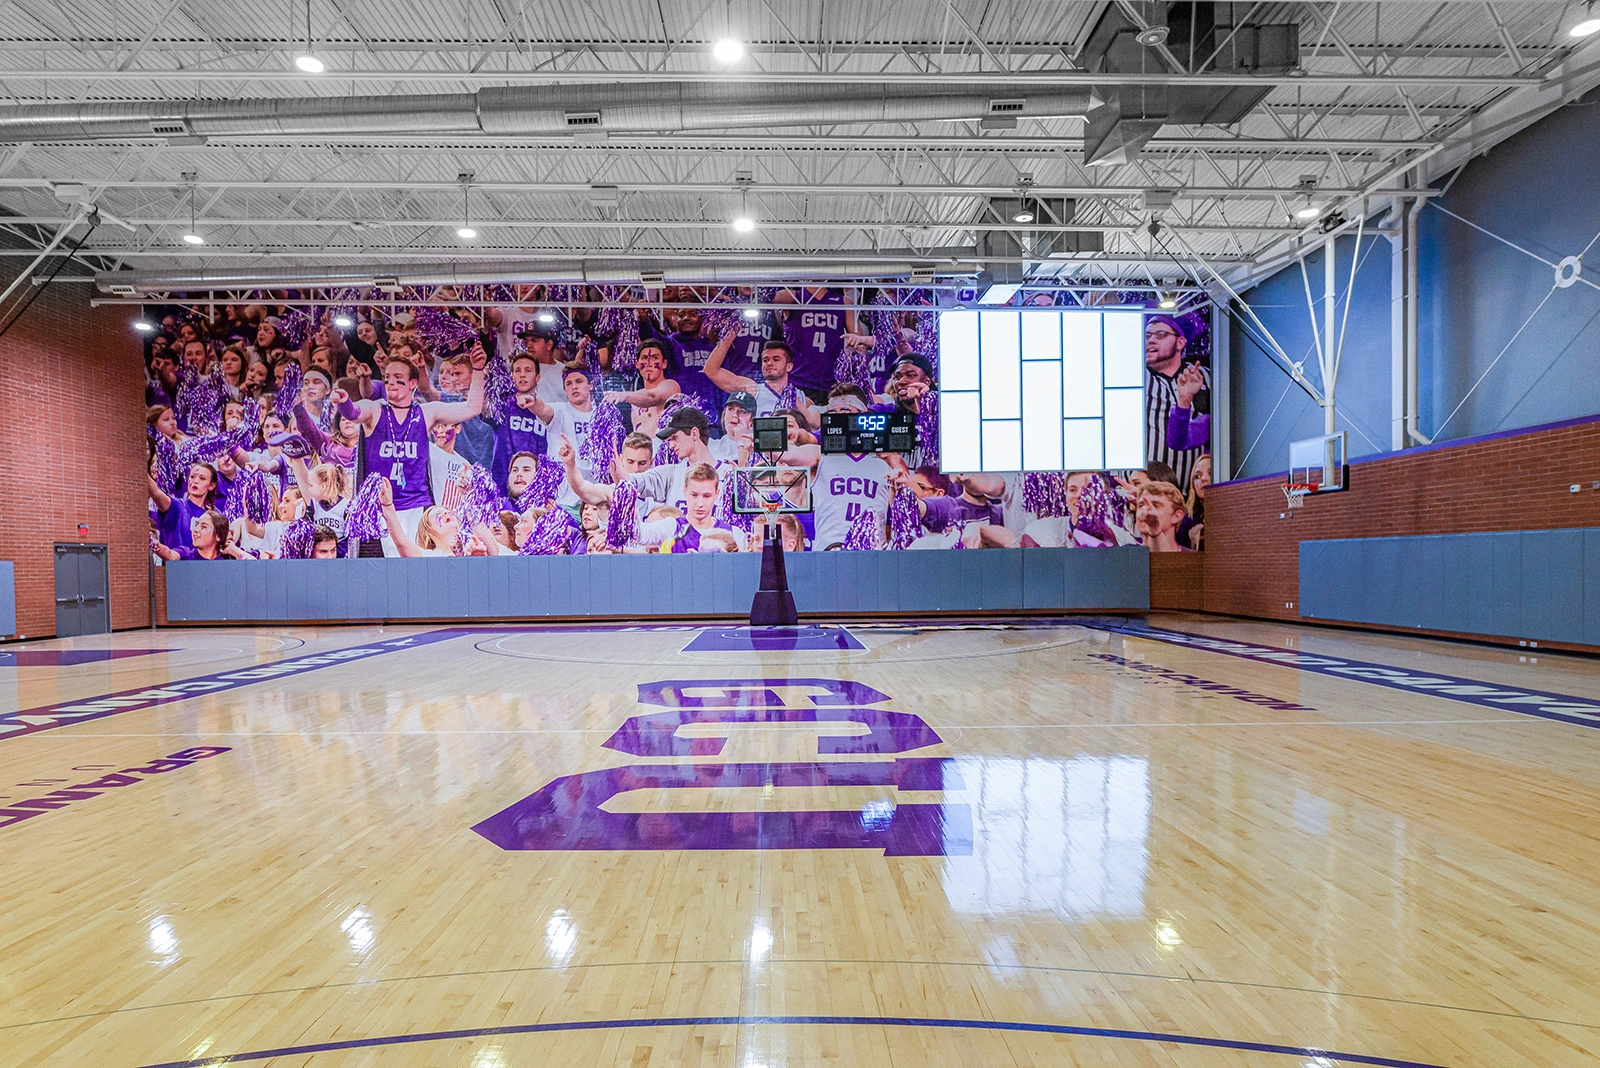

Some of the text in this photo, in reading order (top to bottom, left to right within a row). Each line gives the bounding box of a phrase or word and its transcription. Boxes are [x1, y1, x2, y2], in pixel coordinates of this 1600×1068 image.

[801, 312, 839, 330] GCU
[746, 341, 760, 363] 4
[812, 332, 826, 353] 4
[509, 415, 546, 437] GCU
[827, 427, 843, 435] LOPES
[858, 415, 886, 430] 9:52
[891, 426, 909, 434] GUEST
[379, 440, 419, 459] GCU
[829, 477, 879, 499] GCU
[217, 648, 385, 680] GRAND
[1157, 673, 1319, 711] CANYON
